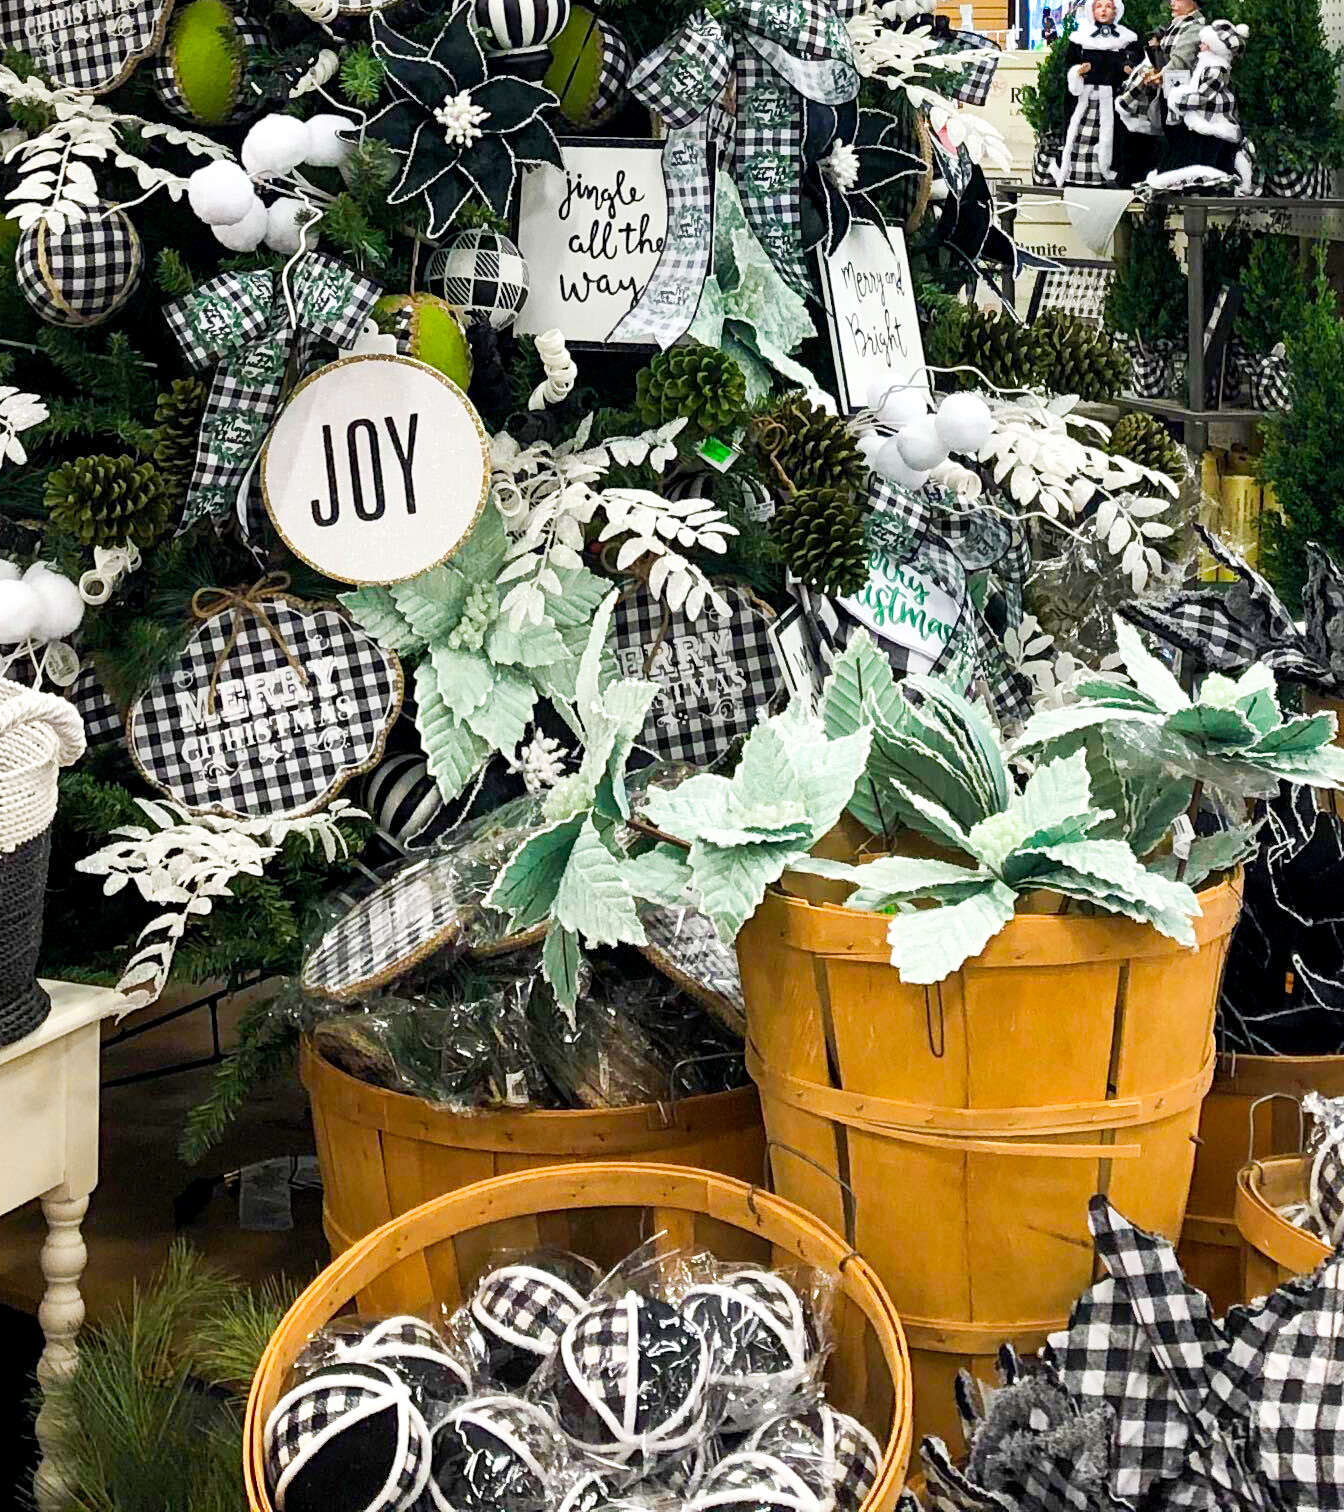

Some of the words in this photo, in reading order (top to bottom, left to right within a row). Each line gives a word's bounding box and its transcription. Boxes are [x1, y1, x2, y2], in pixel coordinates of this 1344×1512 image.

[558, 169, 645, 220] jingle
[568, 219, 618, 260] all
[617, 213, 664, 254] the
[559, 271, 646, 312] way
[840, 261, 887, 307] Merry
[885, 260, 905, 297] and
[845, 308, 908, 369] Bright
[310, 412, 420, 528] JOY
[866, 548, 931, 606] erry
[617, 628, 734, 681] ERRY
[174, 655, 341, 734] MERRY
[181, 694, 360, 765] CHRISTMAS
